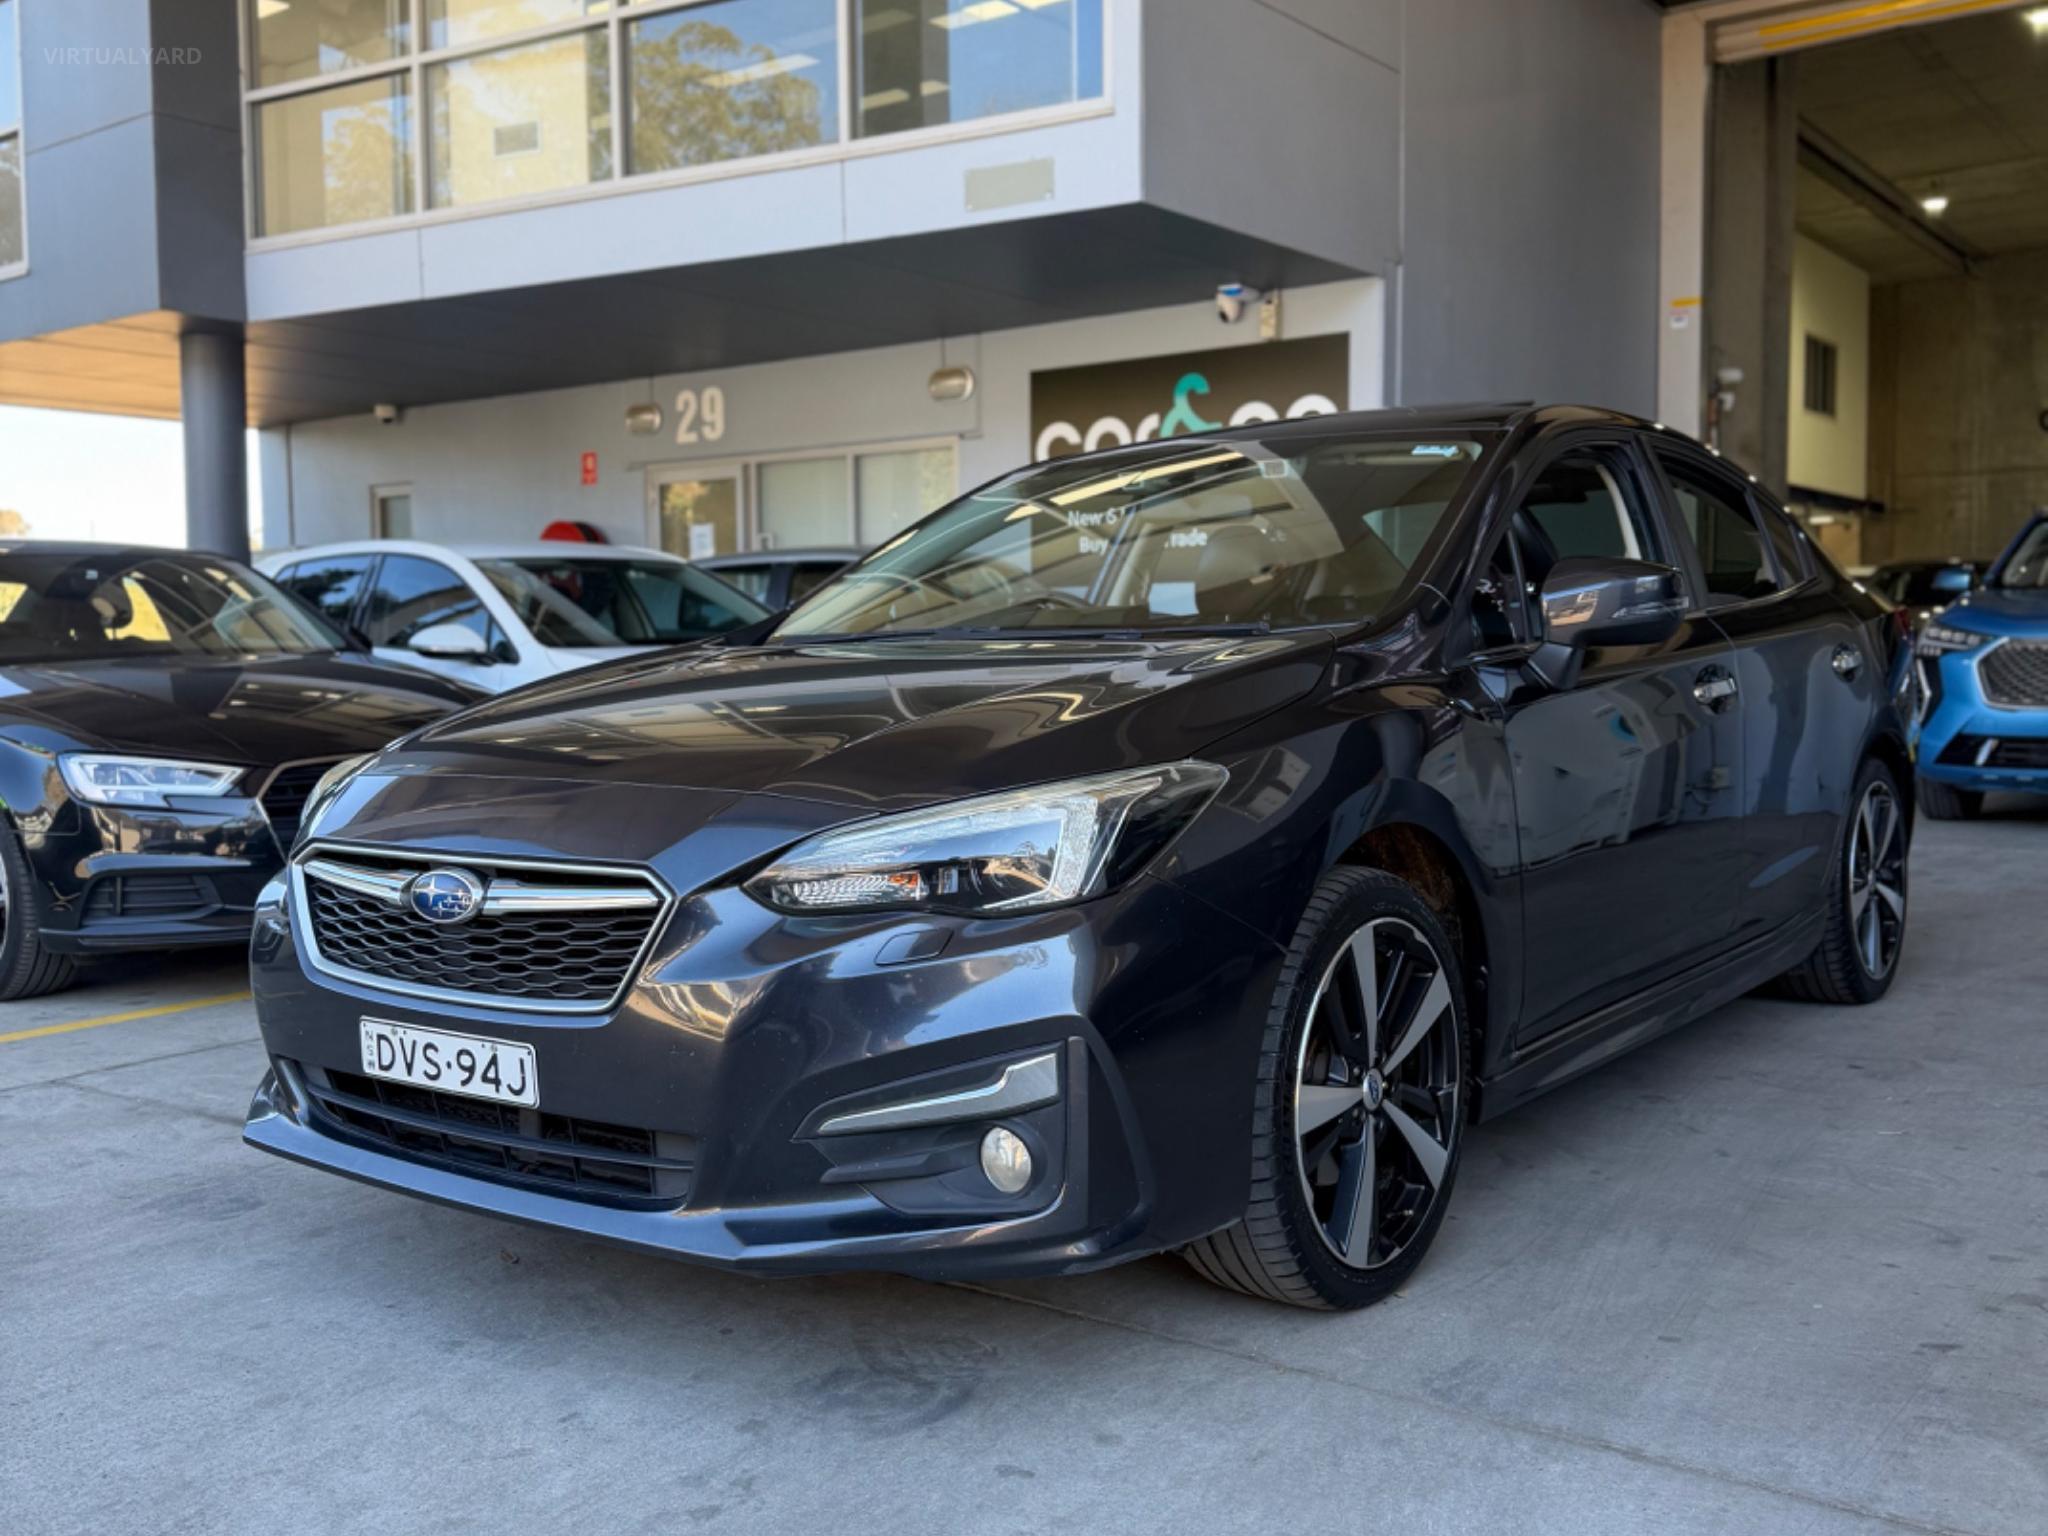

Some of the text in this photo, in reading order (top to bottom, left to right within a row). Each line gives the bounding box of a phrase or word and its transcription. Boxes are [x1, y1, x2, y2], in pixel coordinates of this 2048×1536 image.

[675, 386, 724, 444] 29
[1068, 510, 1102, 527] New
[1079, 527, 1208, 557] Buy rade
